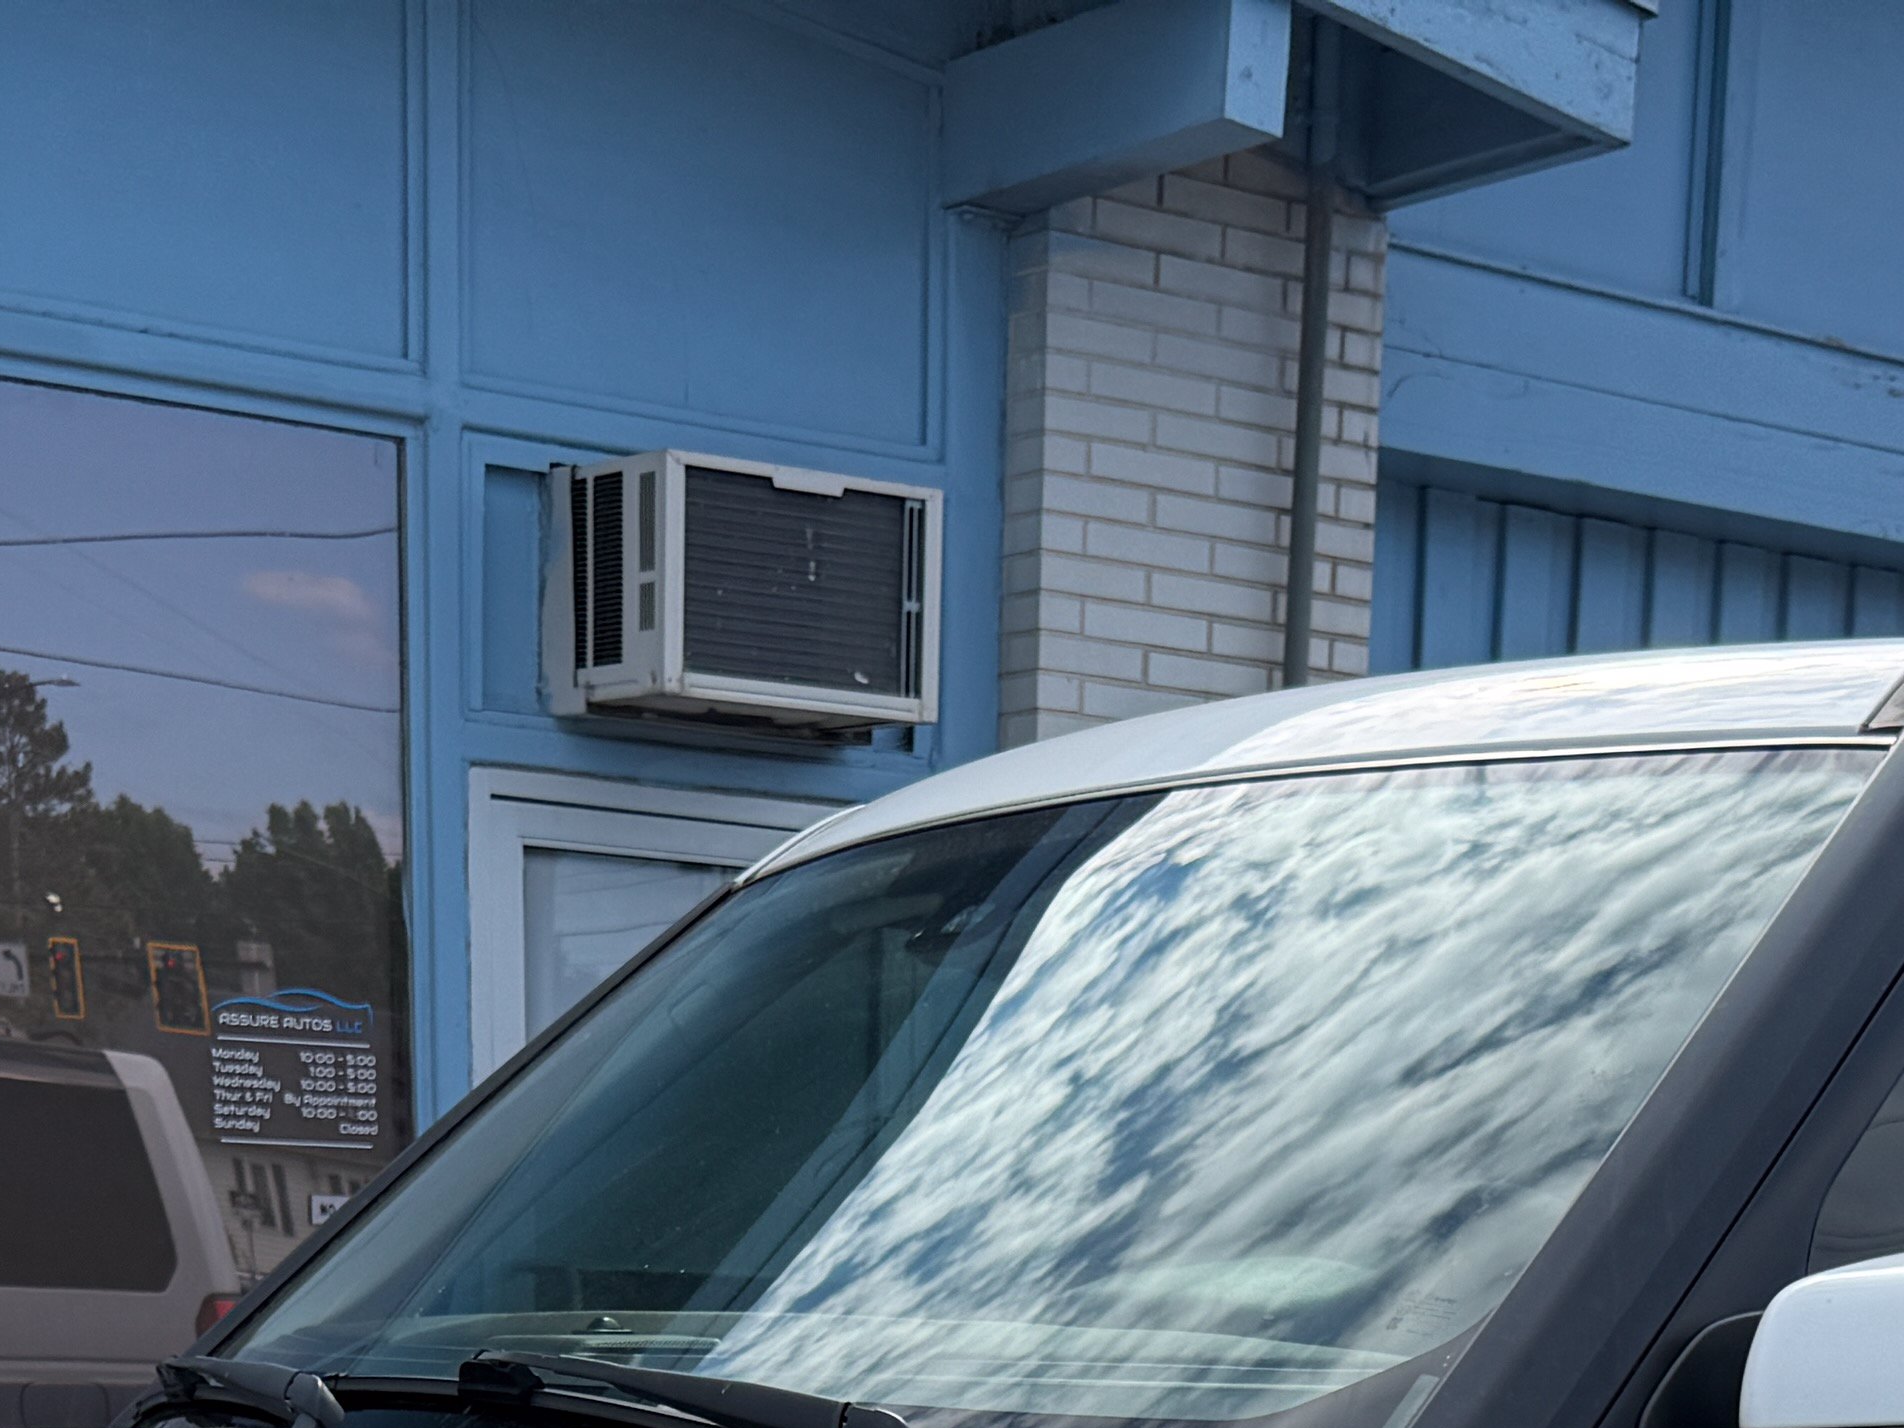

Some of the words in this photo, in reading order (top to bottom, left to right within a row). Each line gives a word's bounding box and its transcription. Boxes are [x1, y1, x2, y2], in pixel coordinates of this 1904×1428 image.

[219, 1012, 279, 1028] ASSURE
[283, 1017, 333, 1032] AUTOS
[336, 1021, 362, 1033] LLC
[211, 1048, 259, 1063] Monday
[300, 1052, 335, 1064] 10:00
[212, 1062, 263, 1077] Tuesday
[212, 1076, 281, 1092] Wednesday
[301, 1080, 336, 1091] 10:00
[213, 1089, 241, 1103] Thur
[245, 1090, 253, 1102] &
[255, 1090, 273, 1103] Fri
[283, 1093, 301, 1107] By
[303, 1094, 377, 1107] Appointment
[213, 1103, 271, 1119] Saturday
[301, 1106, 337, 1119] 10:00
[213, 1117, 260, 1133] Sunday
[339, 1122, 379, 1136] Closed
